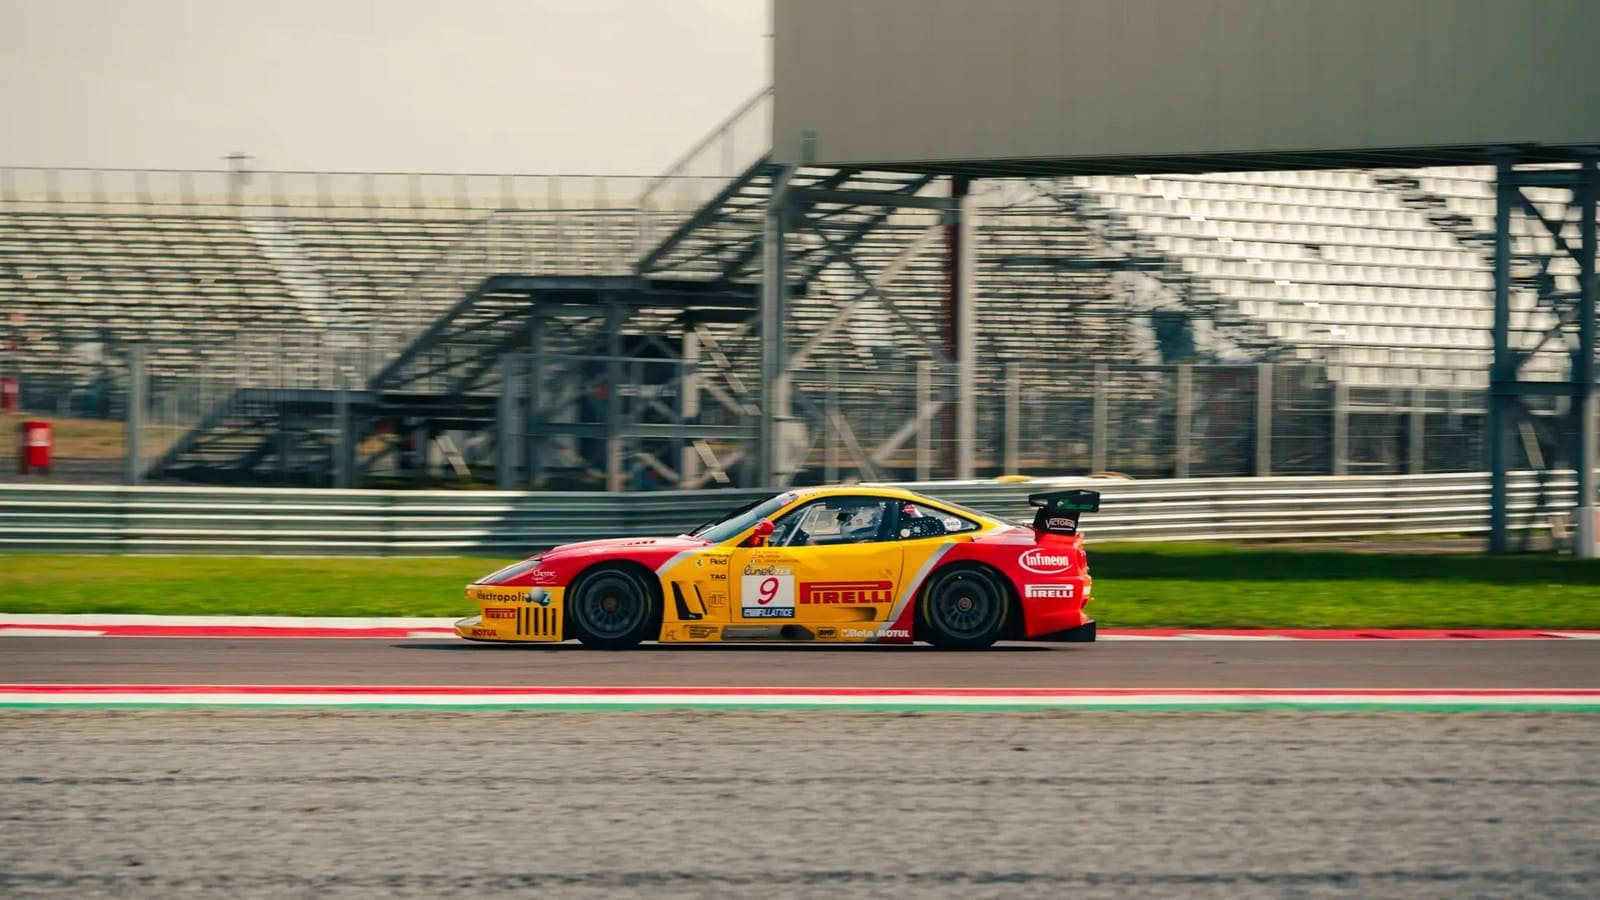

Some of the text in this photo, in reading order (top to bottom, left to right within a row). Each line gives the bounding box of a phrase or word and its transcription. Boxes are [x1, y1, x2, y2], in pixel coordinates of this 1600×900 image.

[1025, 551, 1069, 567] Infineon
[757, 577, 779, 605] 9
[799, 580, 893, 605] PIRELLI
[1024, 584, 1074, 598] PIRELLI
[877, 629, 910, 638] MOTUL
